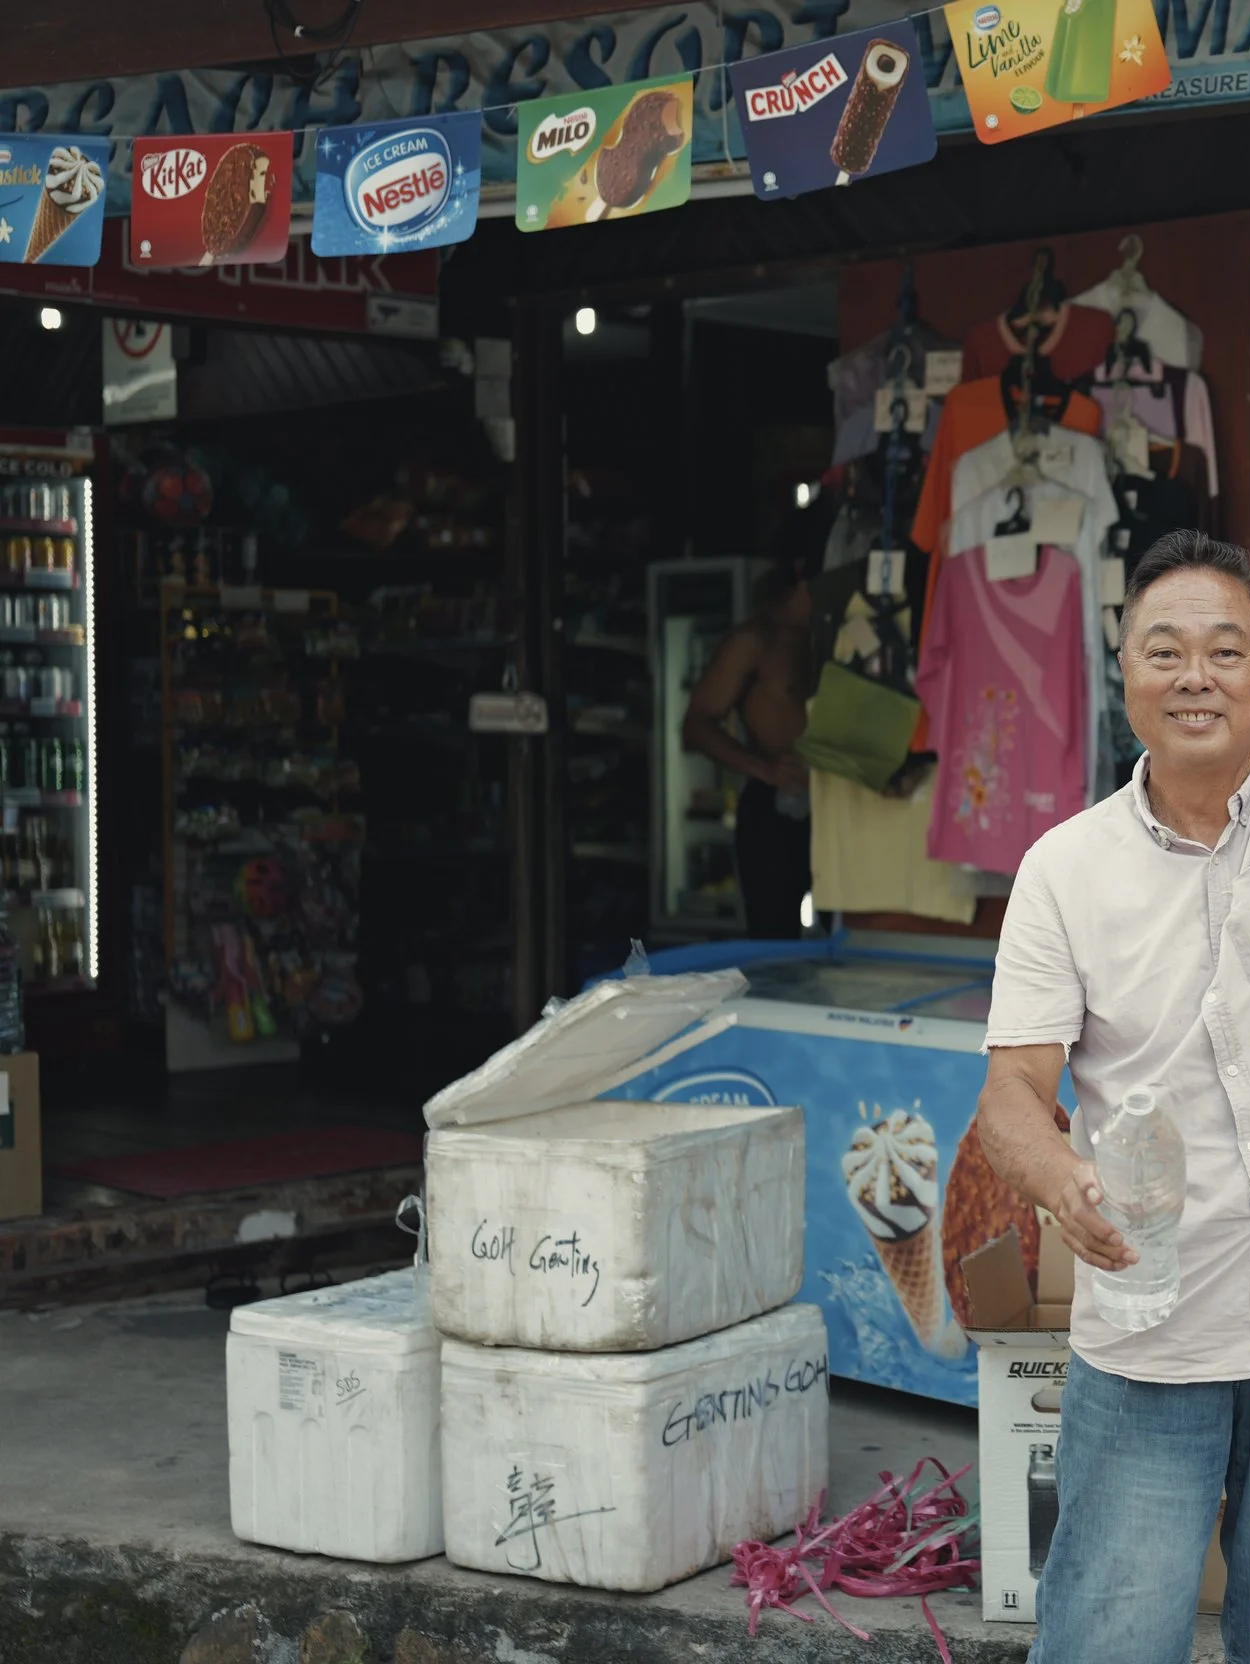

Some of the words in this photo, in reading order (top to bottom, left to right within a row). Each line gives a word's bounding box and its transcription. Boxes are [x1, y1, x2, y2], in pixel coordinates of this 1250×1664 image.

[966, 19, 1021, 70] Lime
[990, 32, 1043, 78] Vanilla
[750, 60, 841, 117] CRUNCH
[363, 153, 382, 173] ICE
[383, 137, 429, 162] CREAM
[537, 121, 590, 152] MILO
[150, 150, 204, 198] KitKat
[363, 162, 445, 218] Nestlé
[24, 459, 73, 479] COLD
[529, 1230, 600, 1308] Genting
[784, 1352, 830, 1399] GOH
